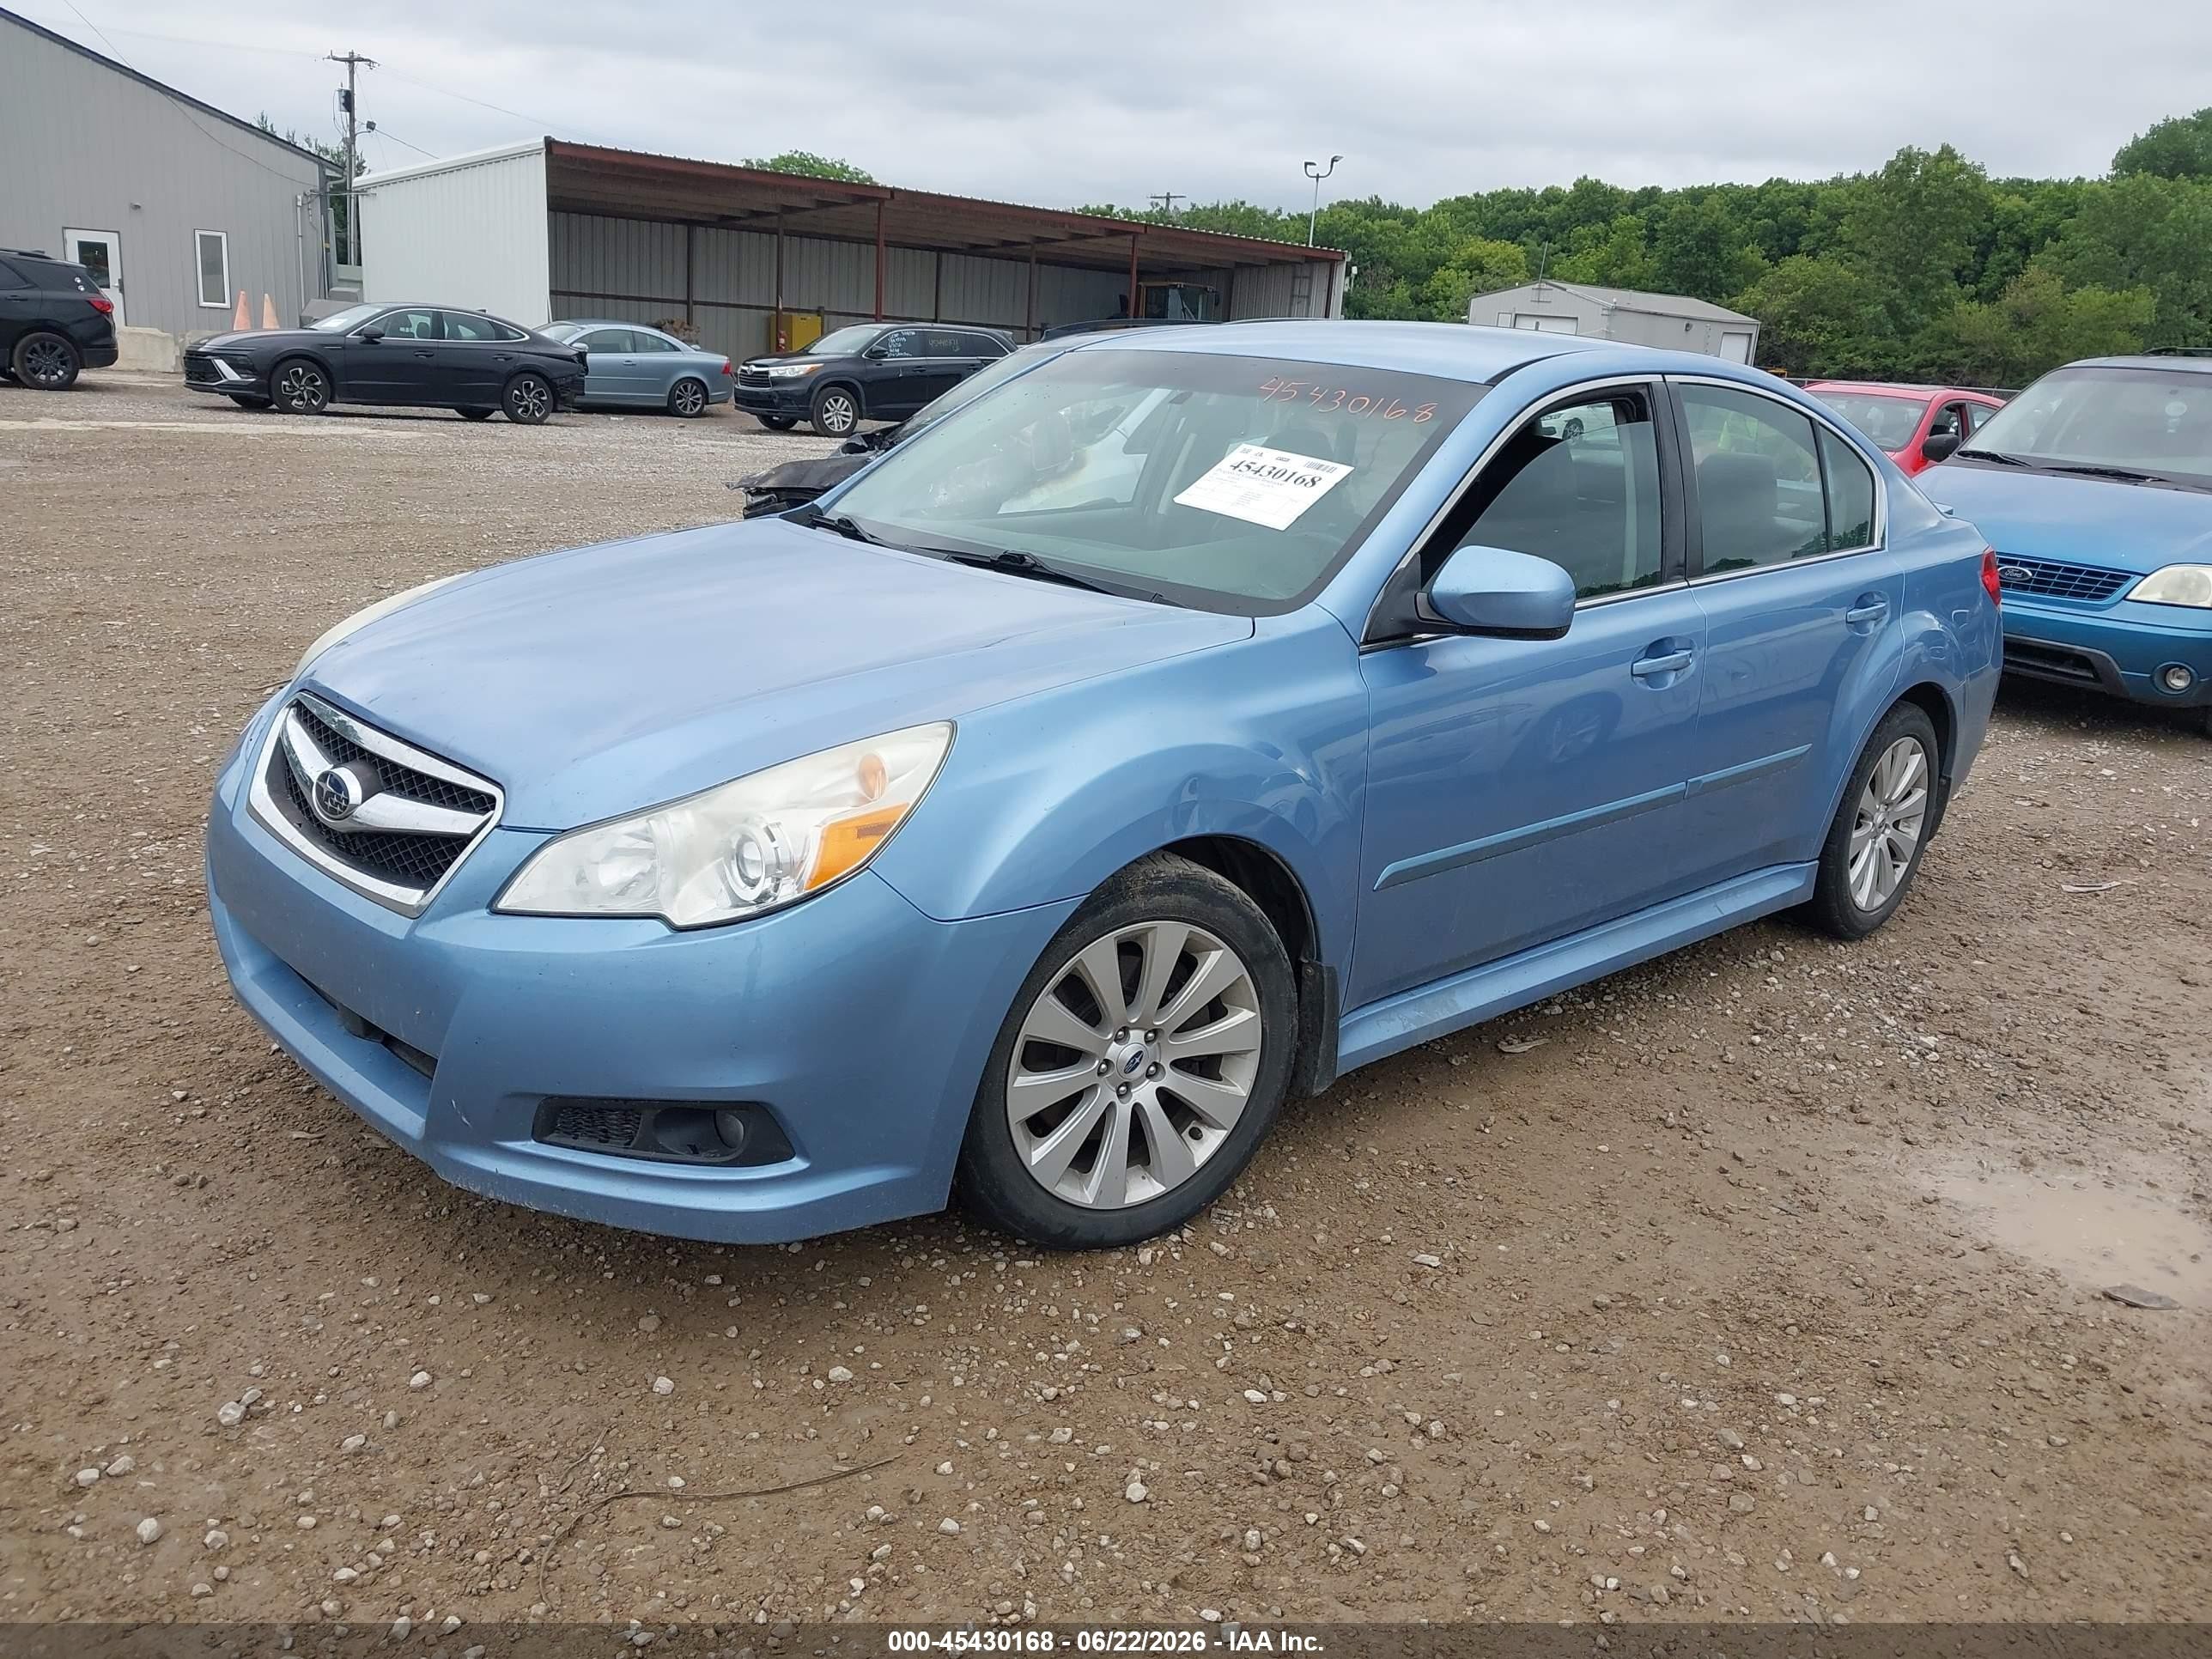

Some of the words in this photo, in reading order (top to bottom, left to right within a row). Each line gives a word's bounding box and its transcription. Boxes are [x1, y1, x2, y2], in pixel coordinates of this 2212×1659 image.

[1260, 377, 1438, 423] 45430168
[1230, 459, 1322, 489] 45430168
[2004, 568, 2023, 578] Ford
